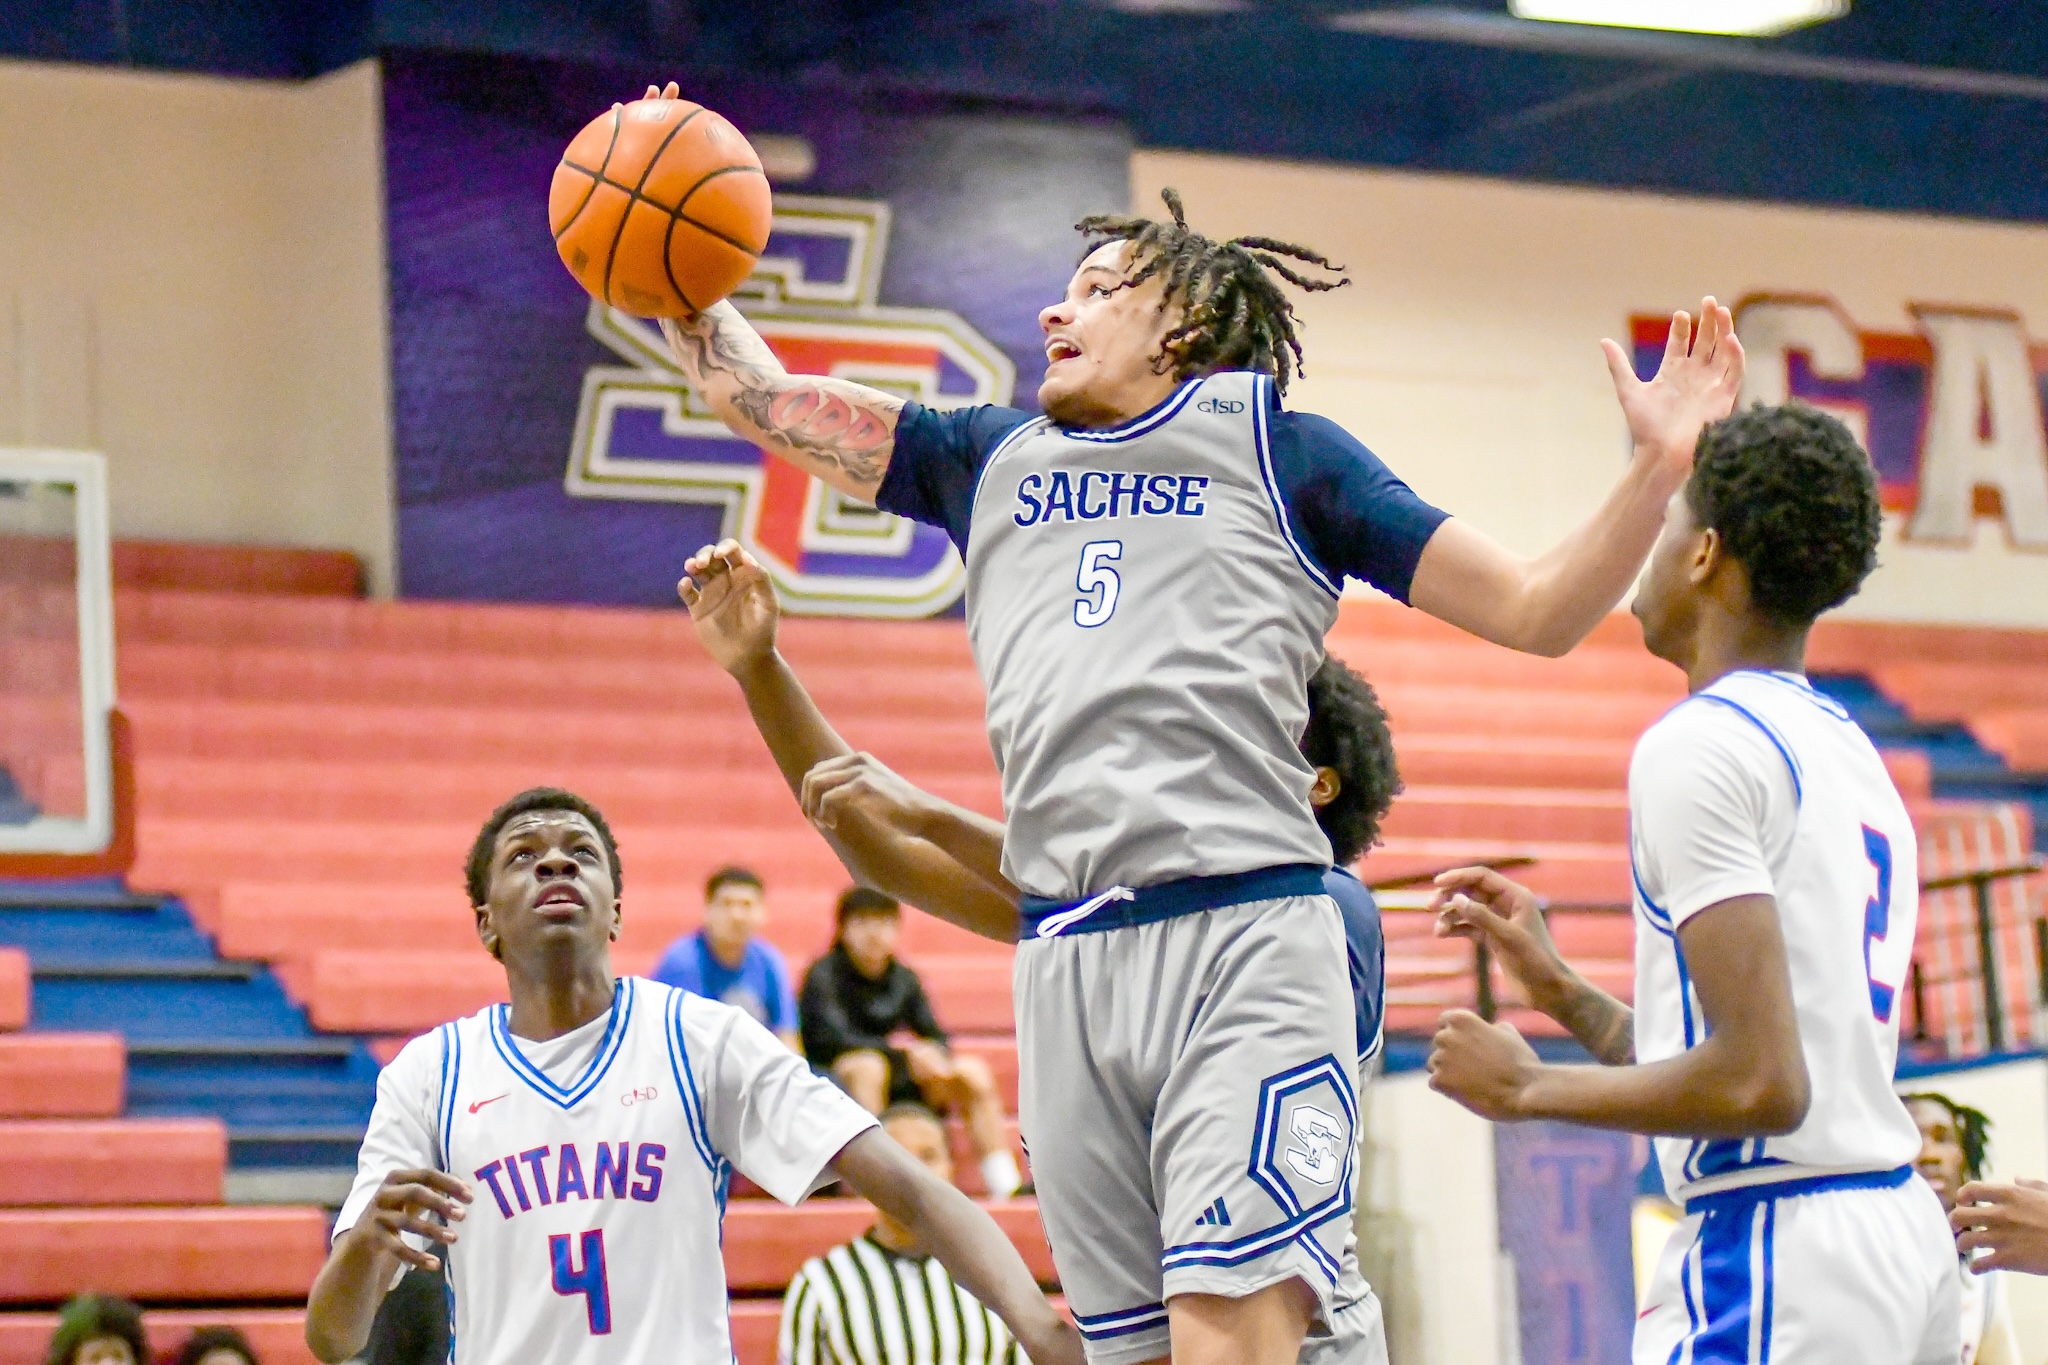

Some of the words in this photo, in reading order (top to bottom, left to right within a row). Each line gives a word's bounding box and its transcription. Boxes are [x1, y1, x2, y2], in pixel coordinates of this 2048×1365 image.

[1197, 397, 1245, 414] GISD
[1013, 471, 1210, 530] SACHSE
[1073, 540, 1123, 628] 5
[1860, 822, 1895, 1024] 2
[474, 1141, 666, 1220] TITANS
[548, 1228, 612, 1336] 4
